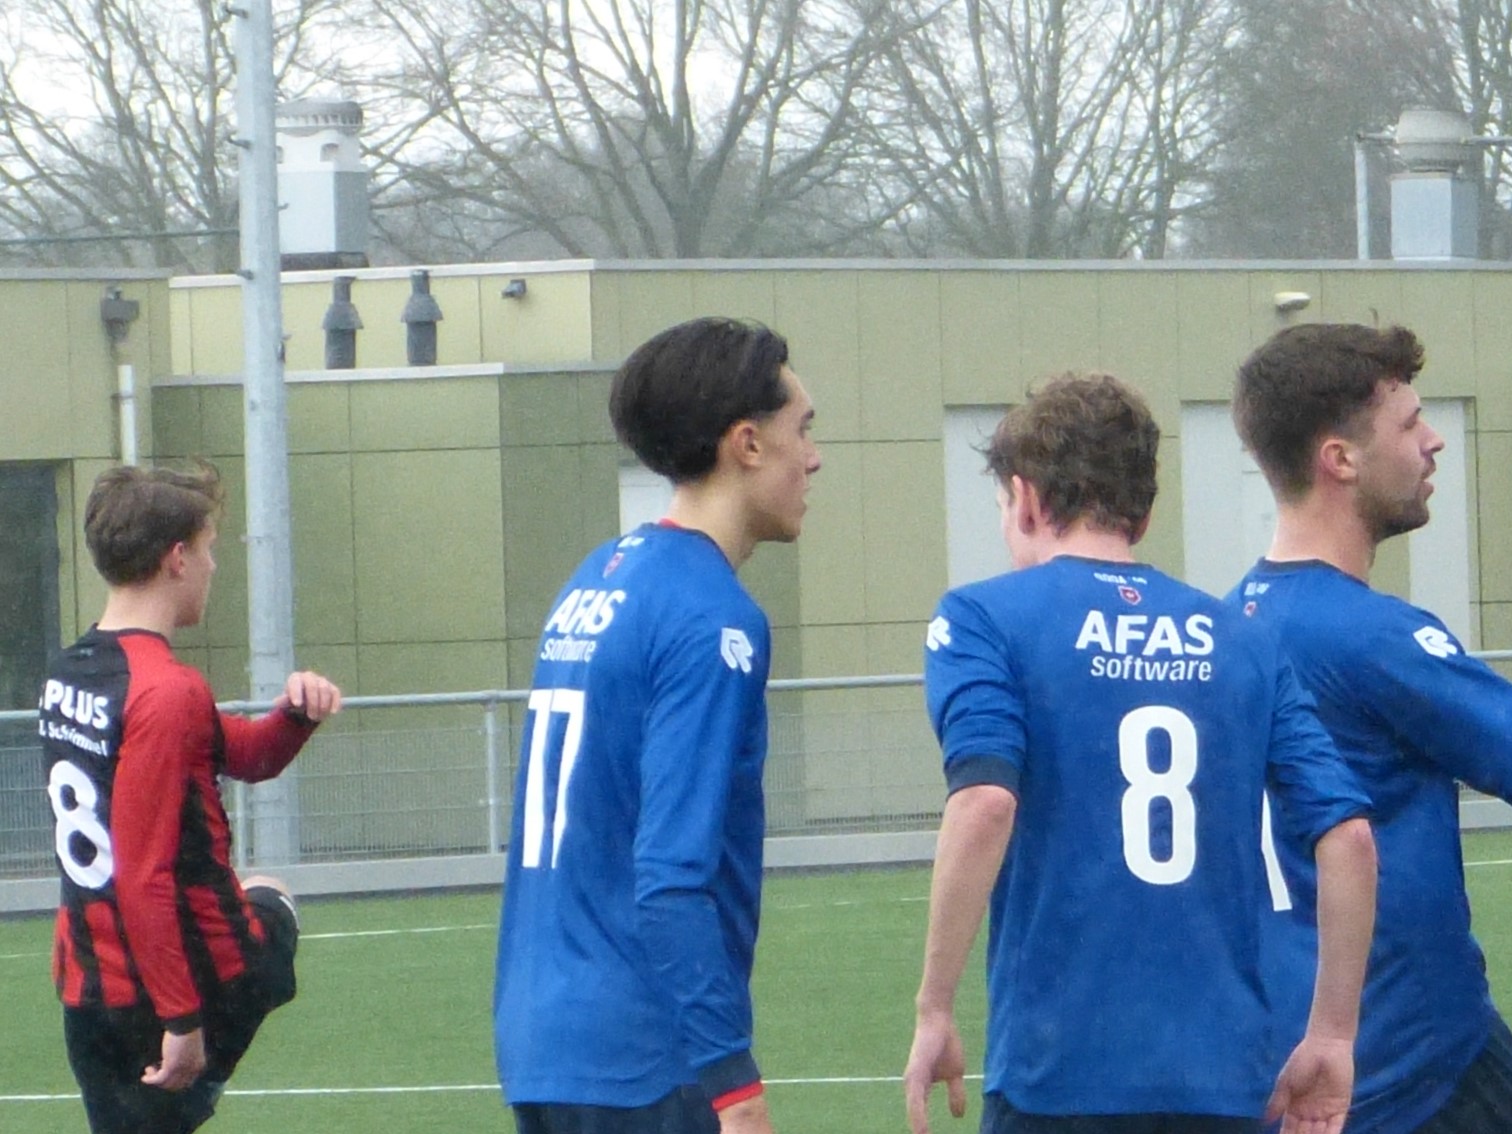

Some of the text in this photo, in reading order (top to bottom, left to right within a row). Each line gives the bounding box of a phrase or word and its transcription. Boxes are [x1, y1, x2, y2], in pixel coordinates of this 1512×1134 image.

[544, 588, 627, 636] AFAS
[1075, 609, 1214, 655] AFAS
[1090, 654, 1212, 682] software
[44, 679, 109, 730] PLUS
[521, 688, 586, 869] 17
[1118, 705, 1198, 885] 8
[47, 759, 115, 891] 8
